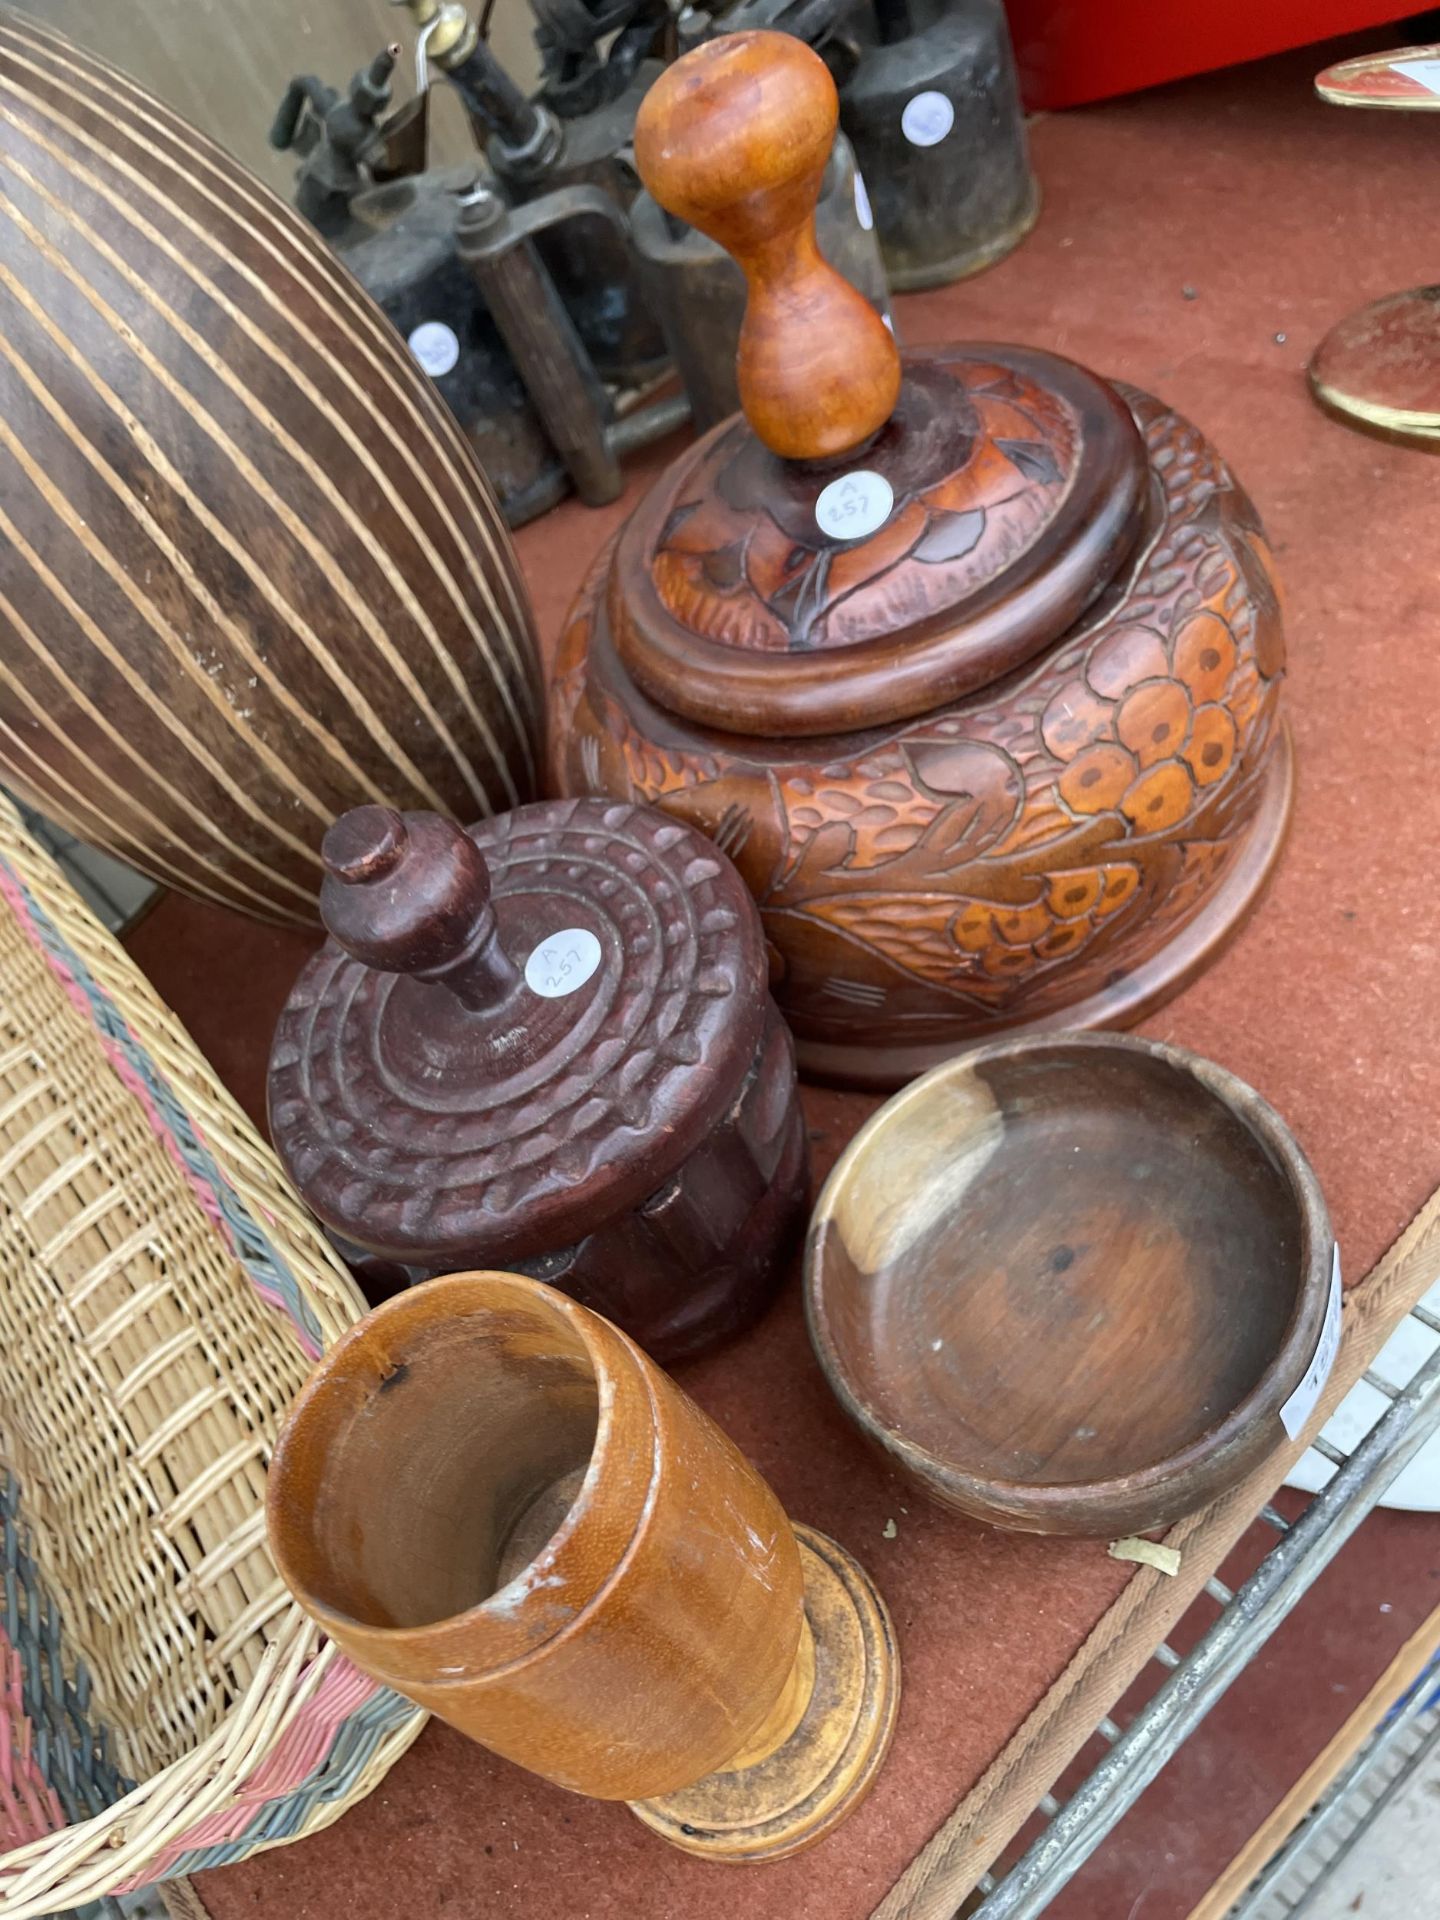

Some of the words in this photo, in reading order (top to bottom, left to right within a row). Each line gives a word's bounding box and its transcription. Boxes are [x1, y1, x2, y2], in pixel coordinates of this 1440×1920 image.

[828, 495, 869, 522] 257
[542, 949, 558, 965] A
[546, 949, 582, 988] 257
